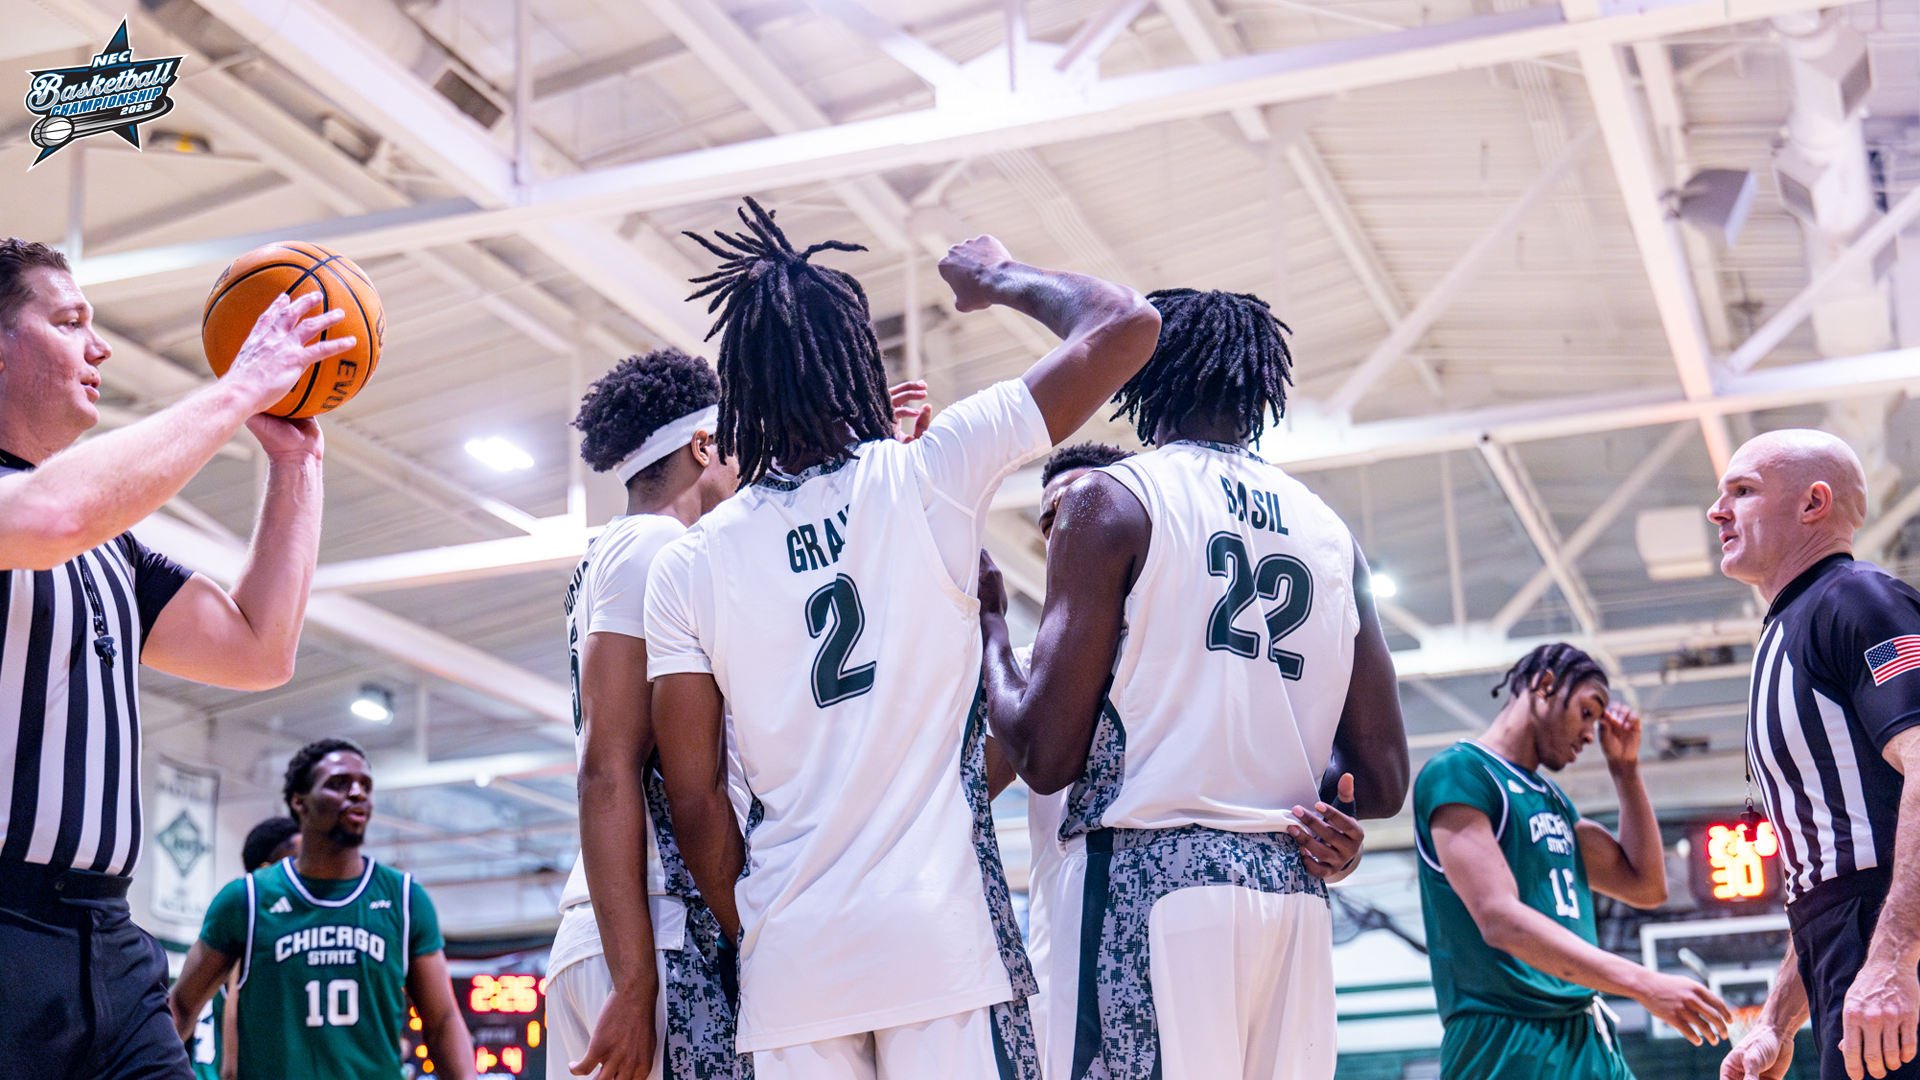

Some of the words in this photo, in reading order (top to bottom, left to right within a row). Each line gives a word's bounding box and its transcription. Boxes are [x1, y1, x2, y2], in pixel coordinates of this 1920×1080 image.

[321, 359, 357, 410] EVO
[1219, 474, 1289, 536] BASIL
[1206, 530, 1314, 681] 22
[805, 572, 877, 709] 2
[1549, 867, 1580, 920] 15
[1709, 856, 1765, 899] 30
[275, 925, 385, 963] CHICAGO
[307, 949, 356, 966] STATE
[304, 978, 360, 1028] 10
